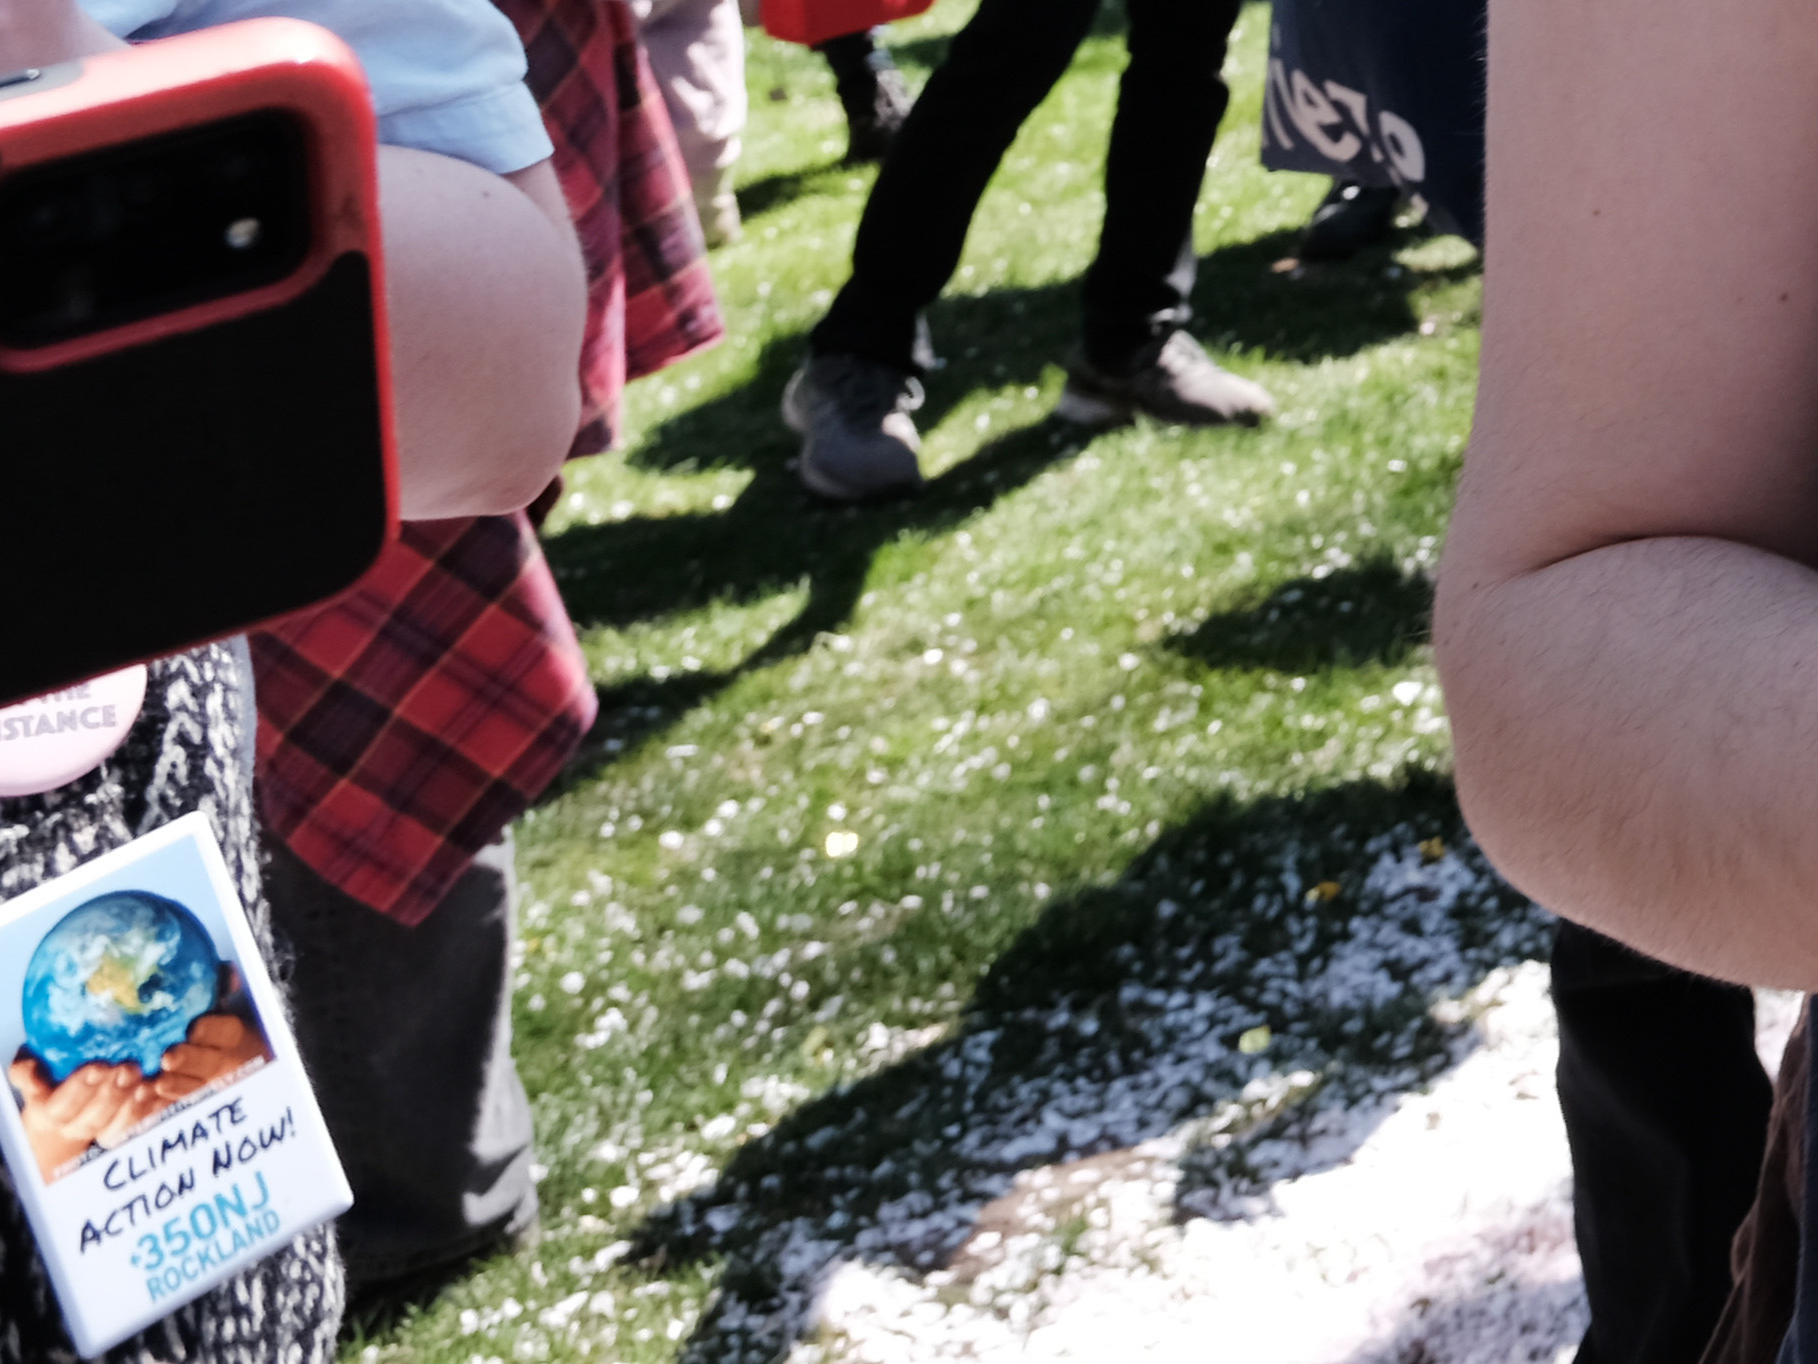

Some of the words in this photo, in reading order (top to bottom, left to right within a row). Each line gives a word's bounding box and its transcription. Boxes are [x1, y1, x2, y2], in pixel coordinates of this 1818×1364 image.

[80, 1167, 195, 1256] ACTION
[212, 1106, 297, 1177] NOW!
[104, 1096, 247, 1191] CLIMATE
[146, 1209, 281, 1302] ROCKLAND
